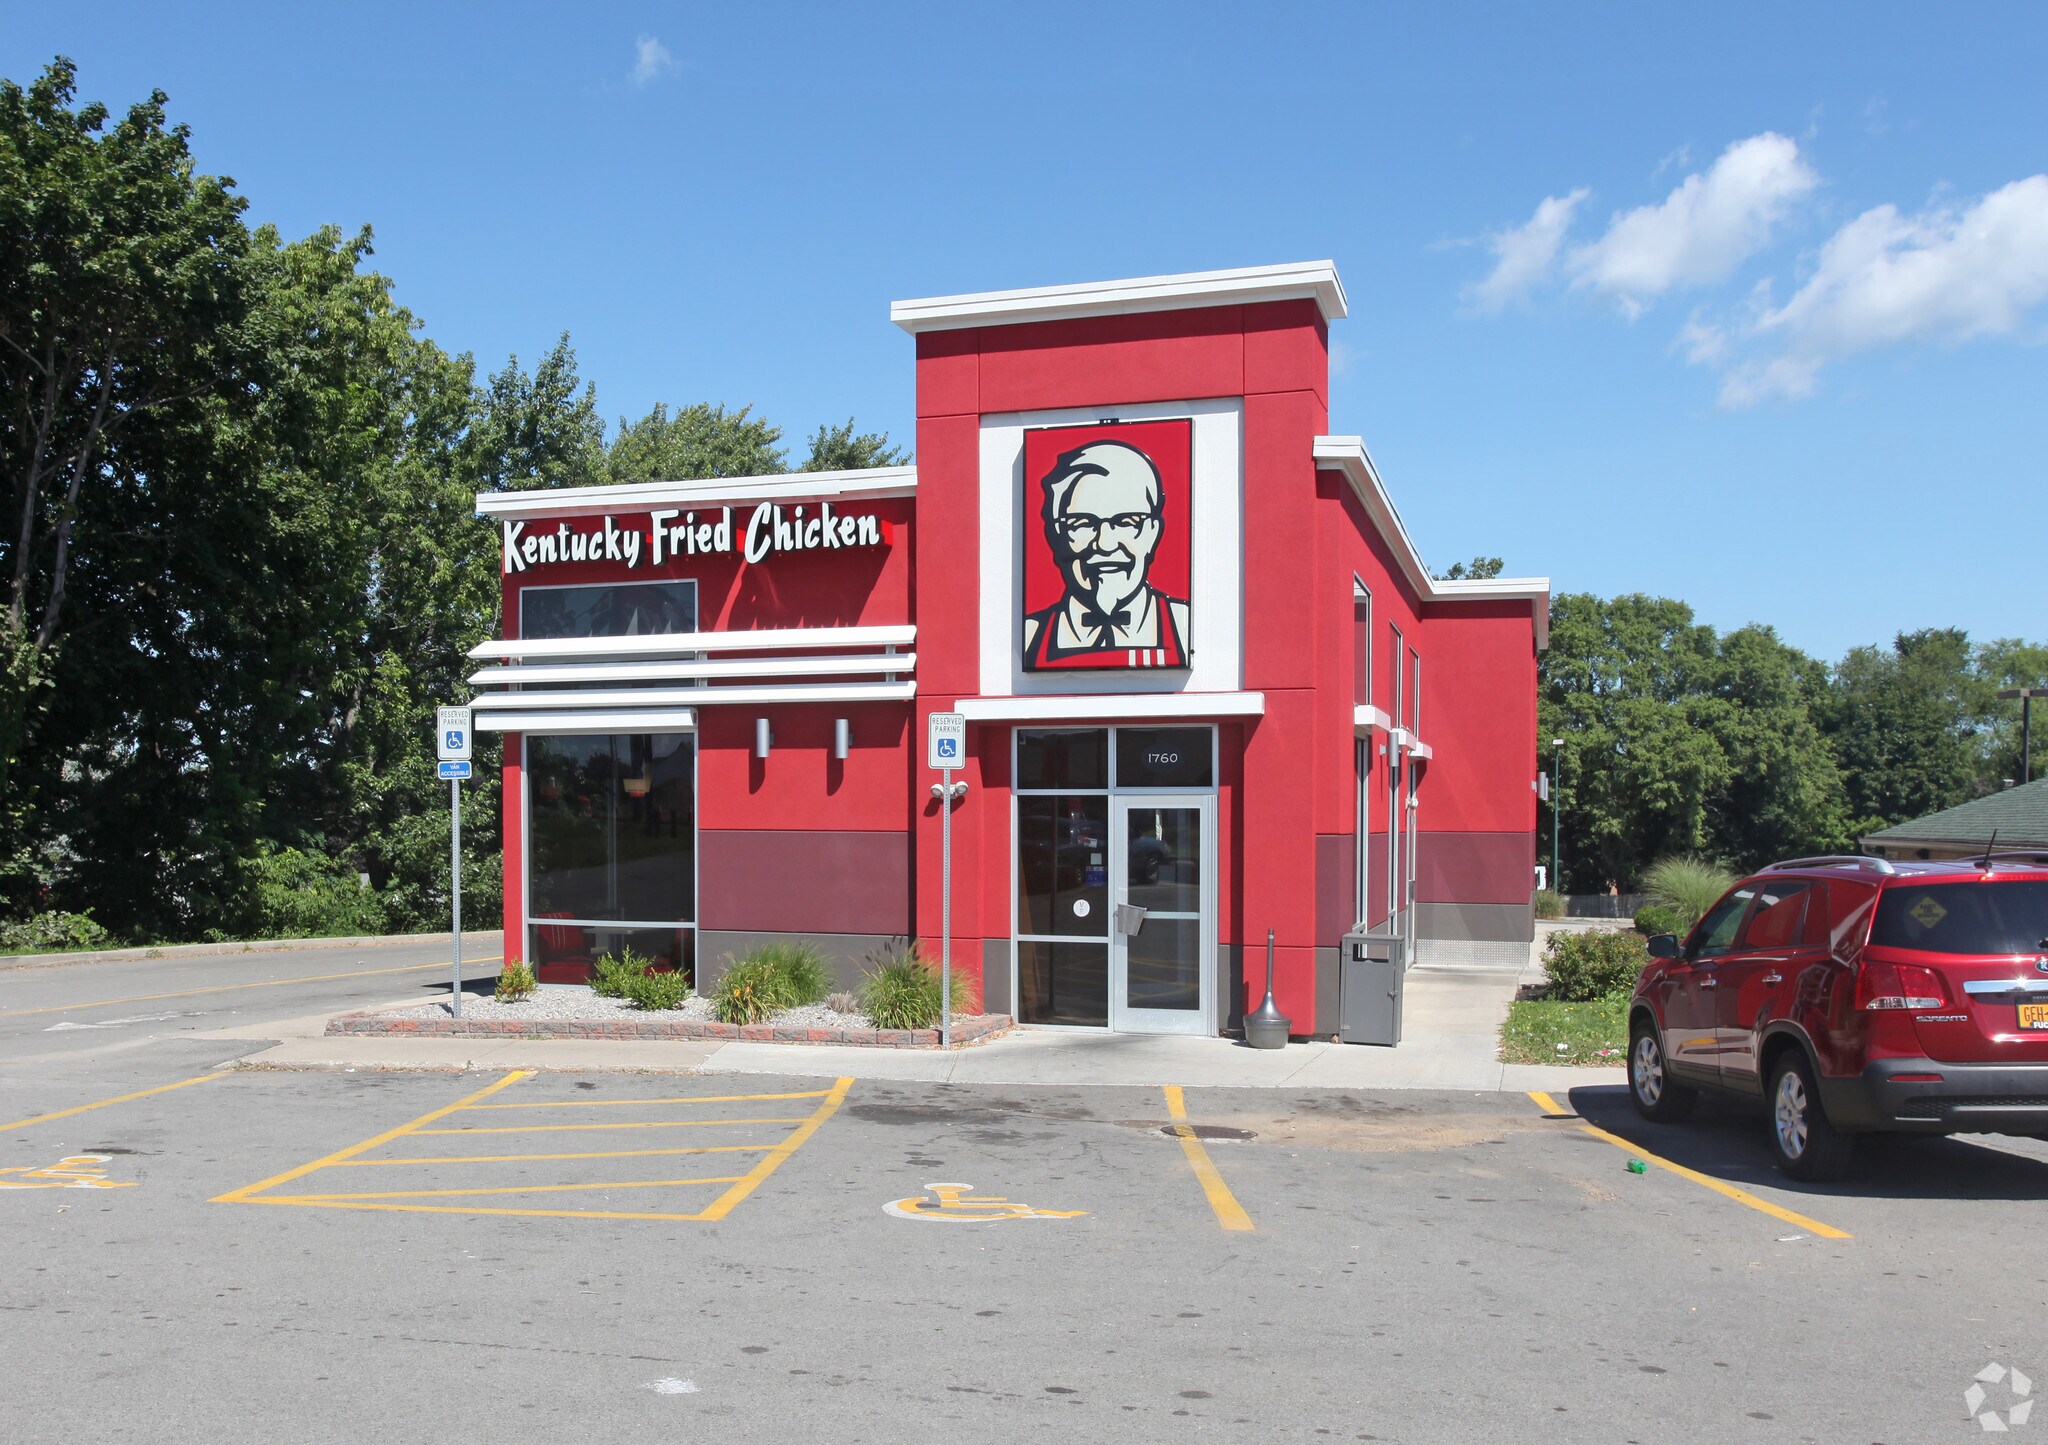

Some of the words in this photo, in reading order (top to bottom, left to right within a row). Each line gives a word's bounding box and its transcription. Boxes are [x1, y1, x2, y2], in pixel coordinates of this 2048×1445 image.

[503, 515, 640, 574] Kentucky
[650, 505, 731, 565] Fried
[744, 501, 880, 564] Chicken
[440, 710, 468, 718] RESERVED
[932, 717, 962, 725] RESERVED
[1148, 753, 1178, 763] 1760
